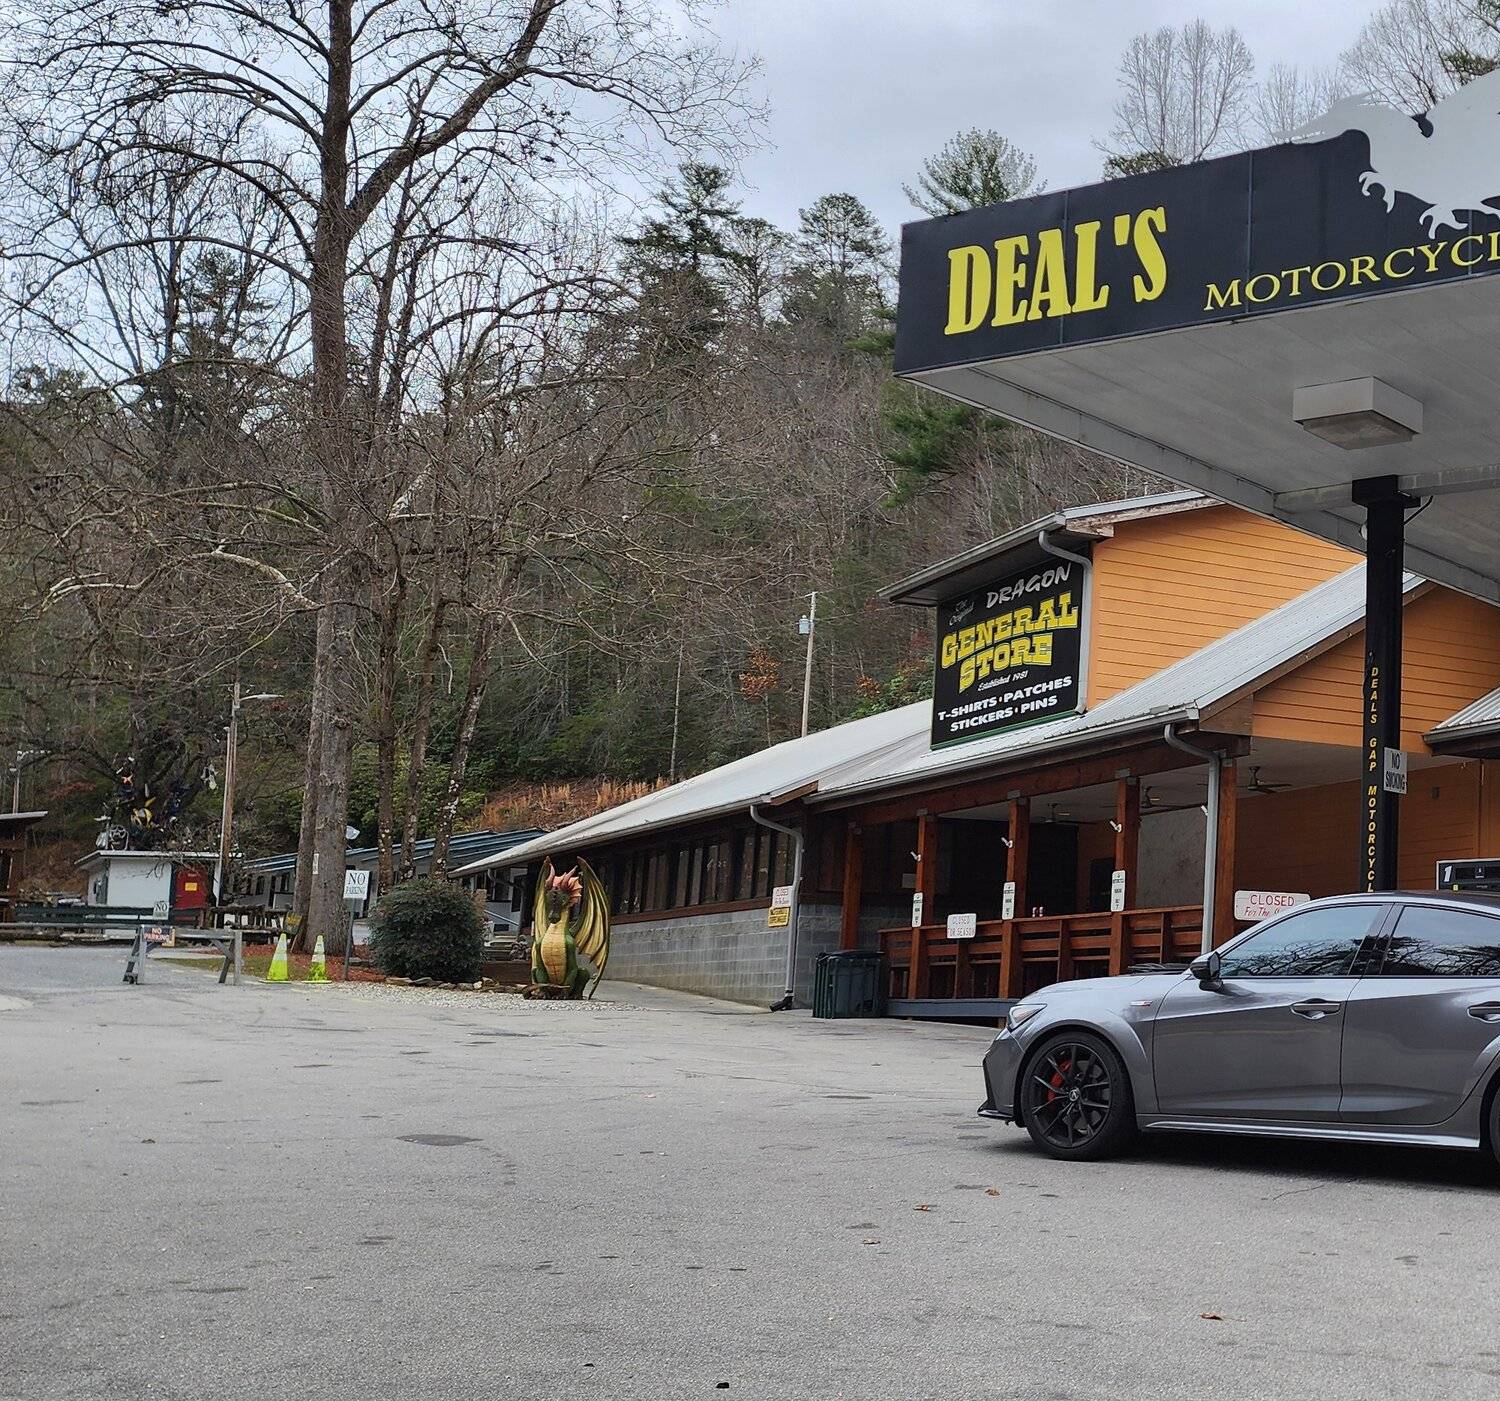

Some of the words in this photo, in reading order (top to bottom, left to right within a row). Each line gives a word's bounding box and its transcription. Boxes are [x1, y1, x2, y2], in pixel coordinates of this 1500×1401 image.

[944, 206, 1167, 335] DEAL'S
[986, 562, 1071, 609] DRAGON
[941, 591, 1079, 669] GENERAL
[958, 632, 1053, 694] STORE
[938, 697, 998, 721] T-SHIRTS
[1002, 676, 1073, 702] PATCHES
[950, 706, 1014, 732] STICKERS
[1021, 695, 1058, 714] PINS
[1370, 667, 1379, 724] DEALS
[1368, 738, 1377, 771] GAP
[1391, 752, 1400, 770] NO
[1366, 785, 1377, 893] MOTORCYCL
[348, 872, 366, 885] NO
[1444, 865, 1452, 882] 1
[1250, 895, 1294, 907] CLOSED
